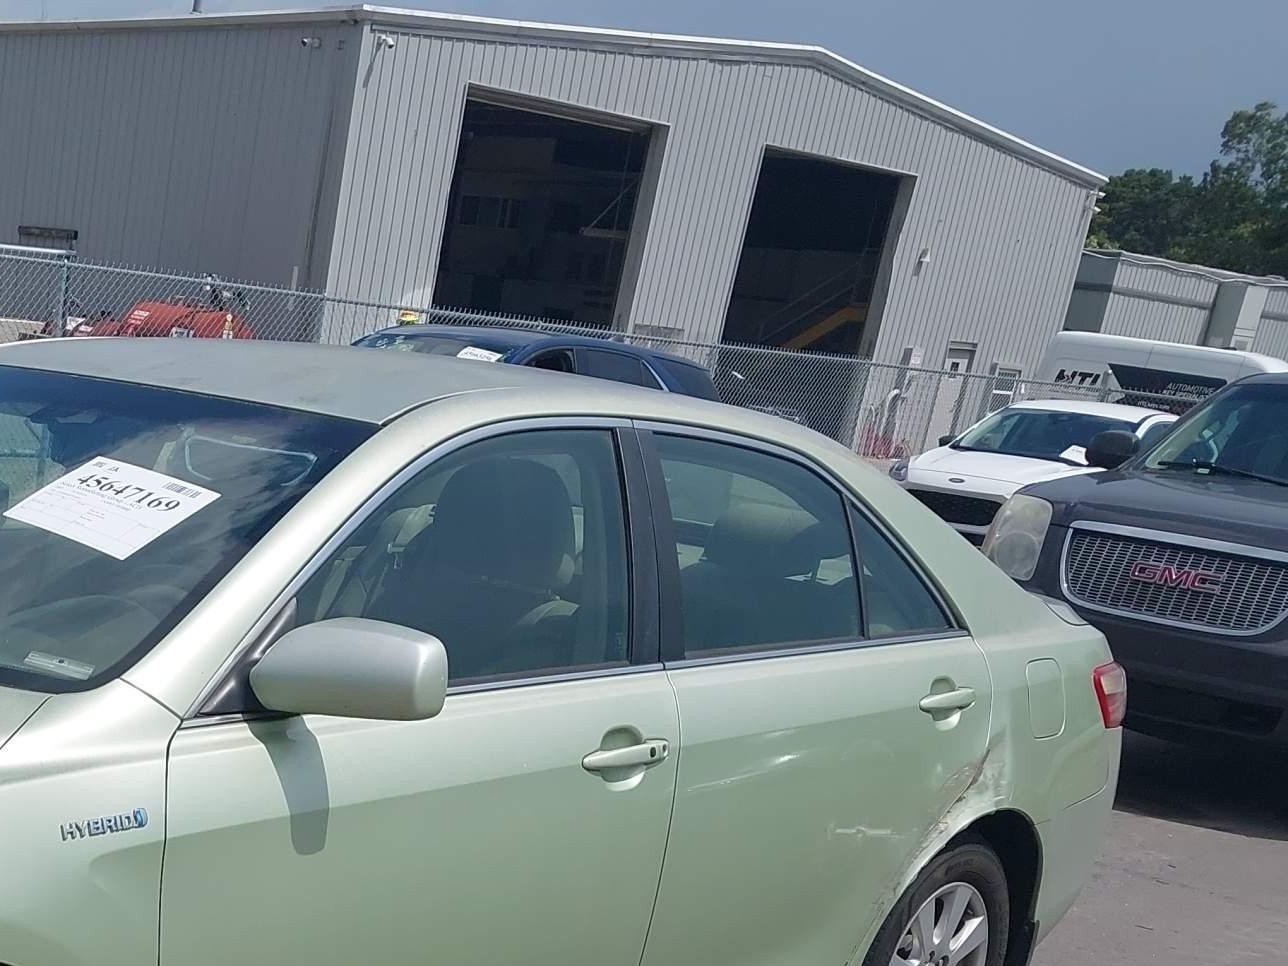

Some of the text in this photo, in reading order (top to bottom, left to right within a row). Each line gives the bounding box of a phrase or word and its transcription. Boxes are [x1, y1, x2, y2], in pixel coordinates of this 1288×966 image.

[77, 473, 181, 512] 45647169
[1130, 560, 1226, 595] GMC
[59, 812, 134, 841] HYBRID
